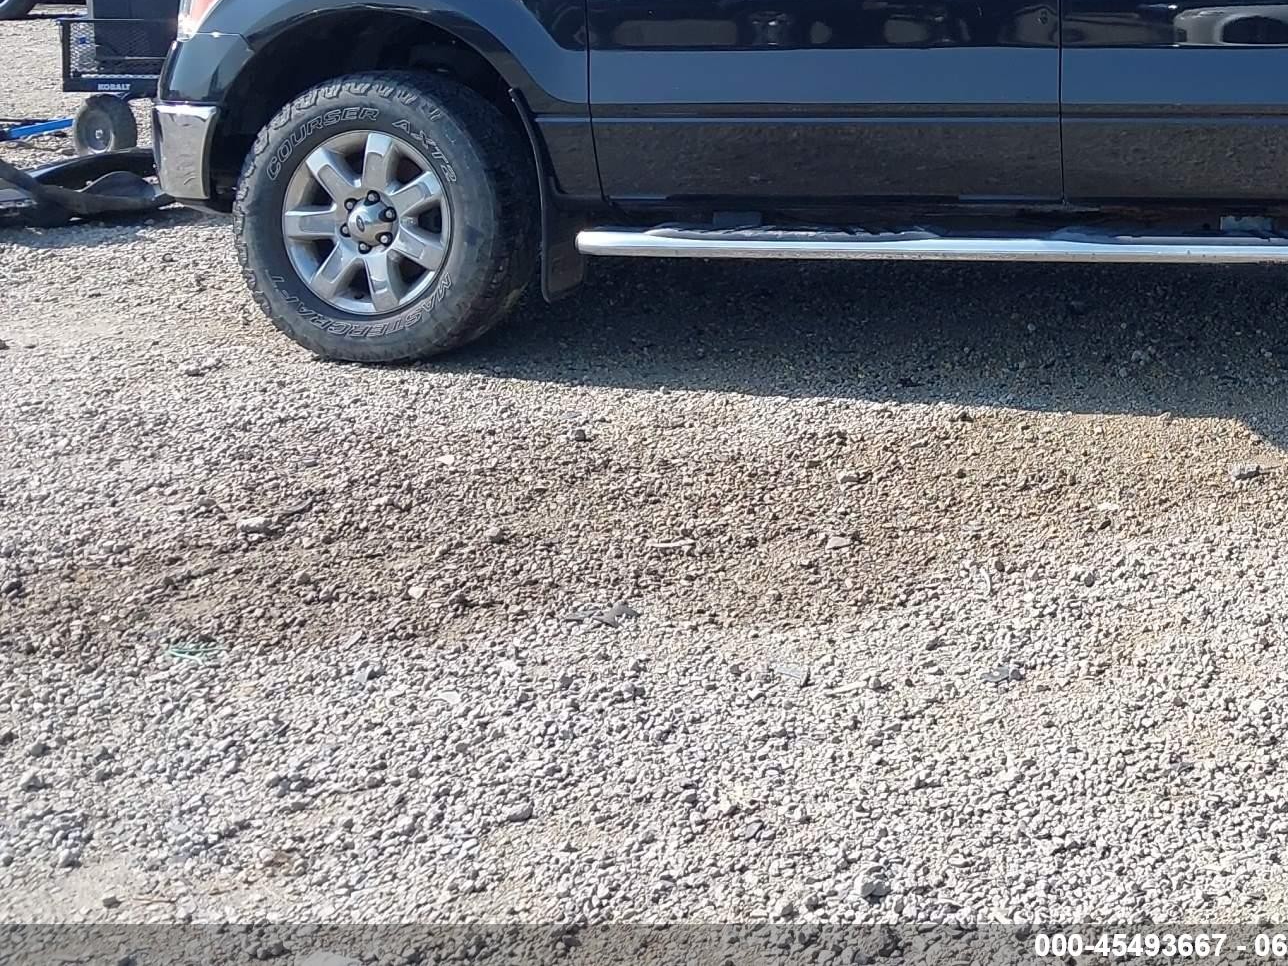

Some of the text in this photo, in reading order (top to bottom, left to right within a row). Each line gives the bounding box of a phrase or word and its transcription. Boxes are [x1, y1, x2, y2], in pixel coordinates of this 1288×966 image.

[98, 83, 131, 91] KOBALT
[265, 106, 457, 183] COURSER AXT2
[264, 269, 453, 339] MASTERCRAFT
